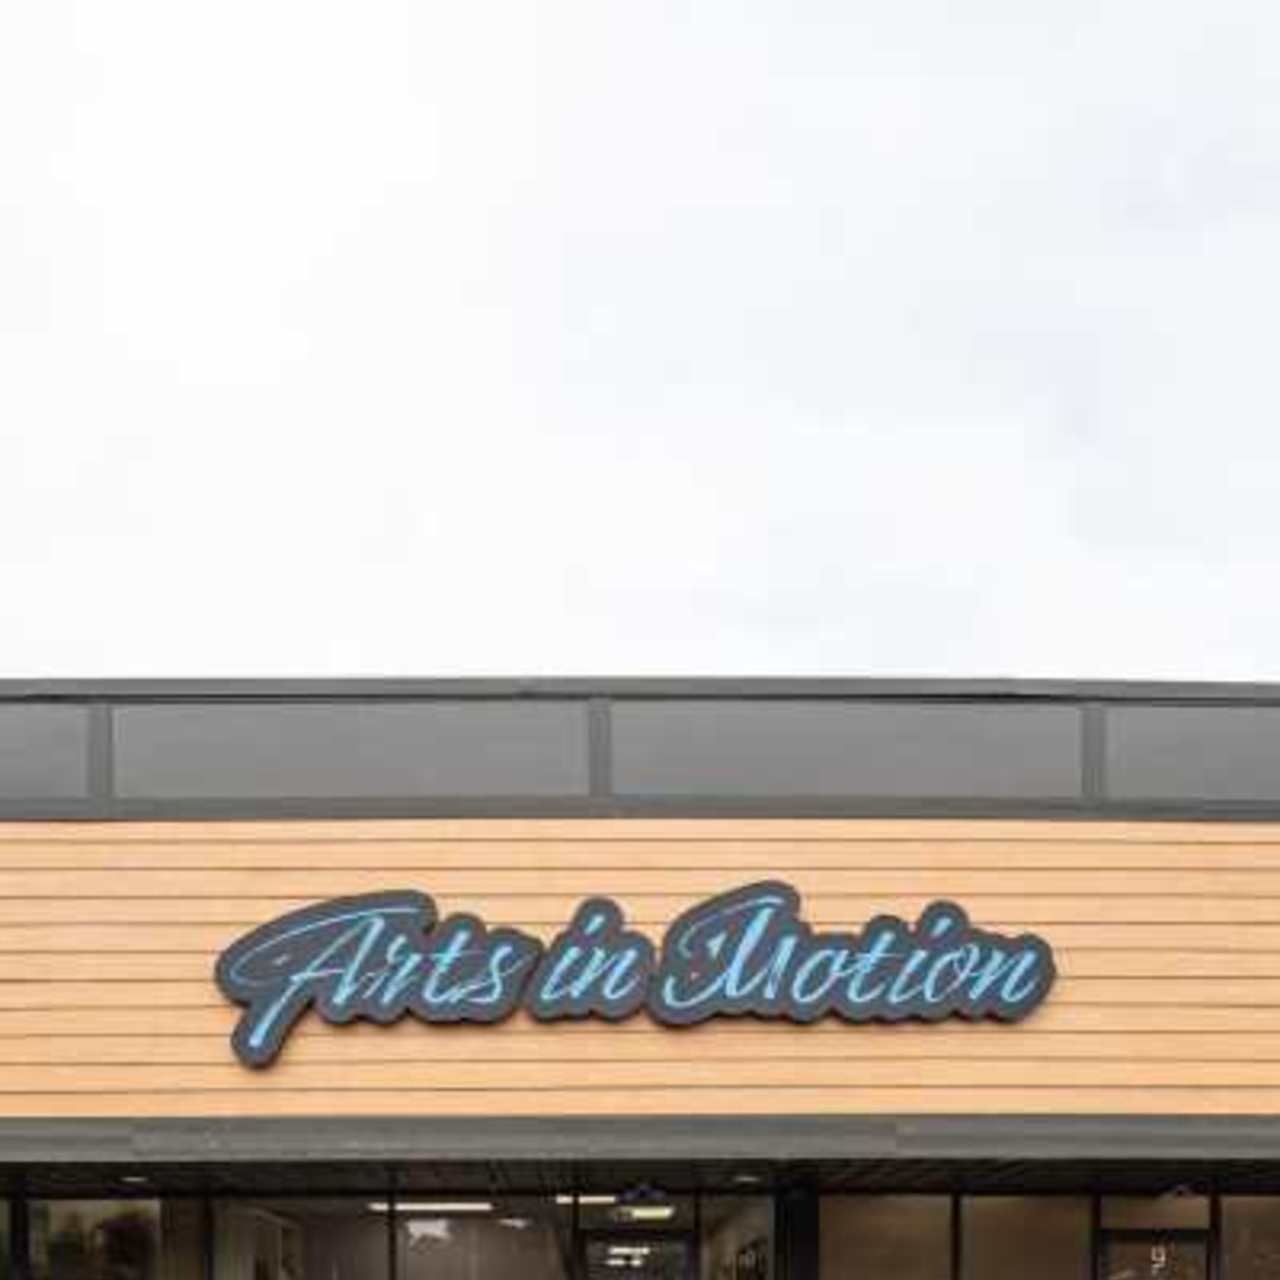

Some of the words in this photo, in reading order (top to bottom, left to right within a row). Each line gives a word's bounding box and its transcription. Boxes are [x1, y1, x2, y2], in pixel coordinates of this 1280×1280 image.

[229, 905, 522, 1050] Arts
[539, 912, 642, 1004] in
[662, 894, 1039, 1009] Motion
[1151, 1245, 1167, 1274] 9
